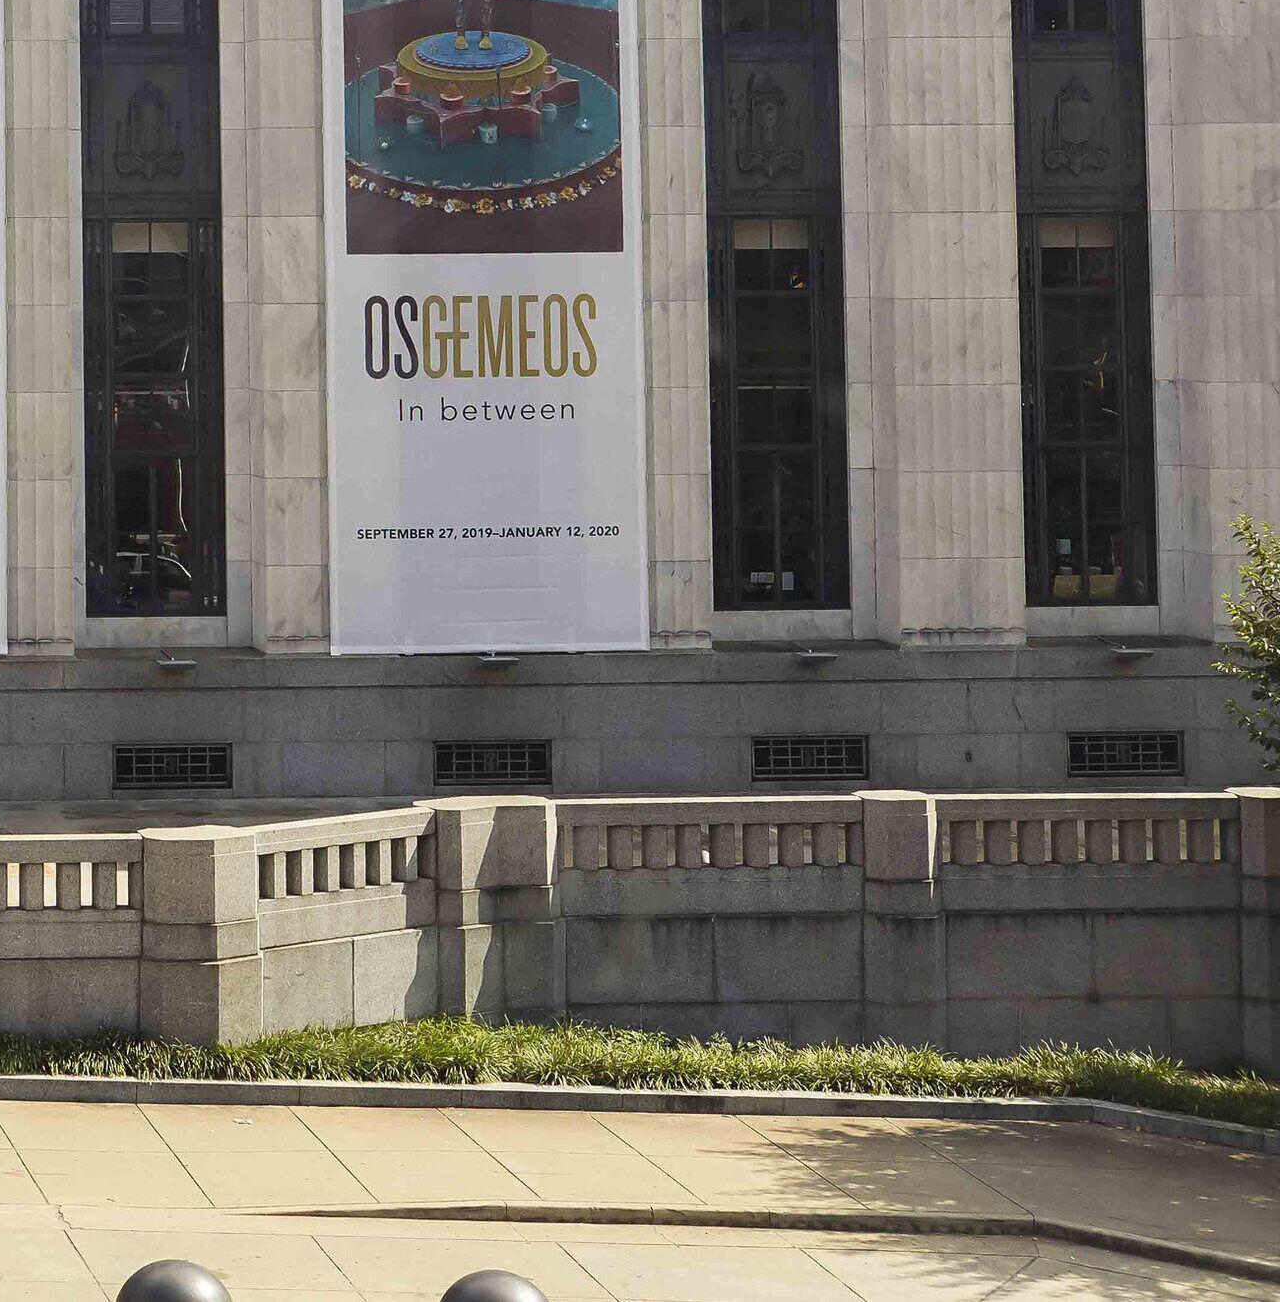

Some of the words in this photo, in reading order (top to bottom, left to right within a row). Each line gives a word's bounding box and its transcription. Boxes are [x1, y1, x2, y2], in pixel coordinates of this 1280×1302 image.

[363, 293, 599, 380] OSGEMEOS
[398, 398, 424, 422] In
[440, 397, 576, 422] between
[356, 527, 435, 541] SEPTEMBER
[438, 527, 458, 540] 27,
[565, 526, 585, 538] 12,
[588, 525, 621, 538] 2020
